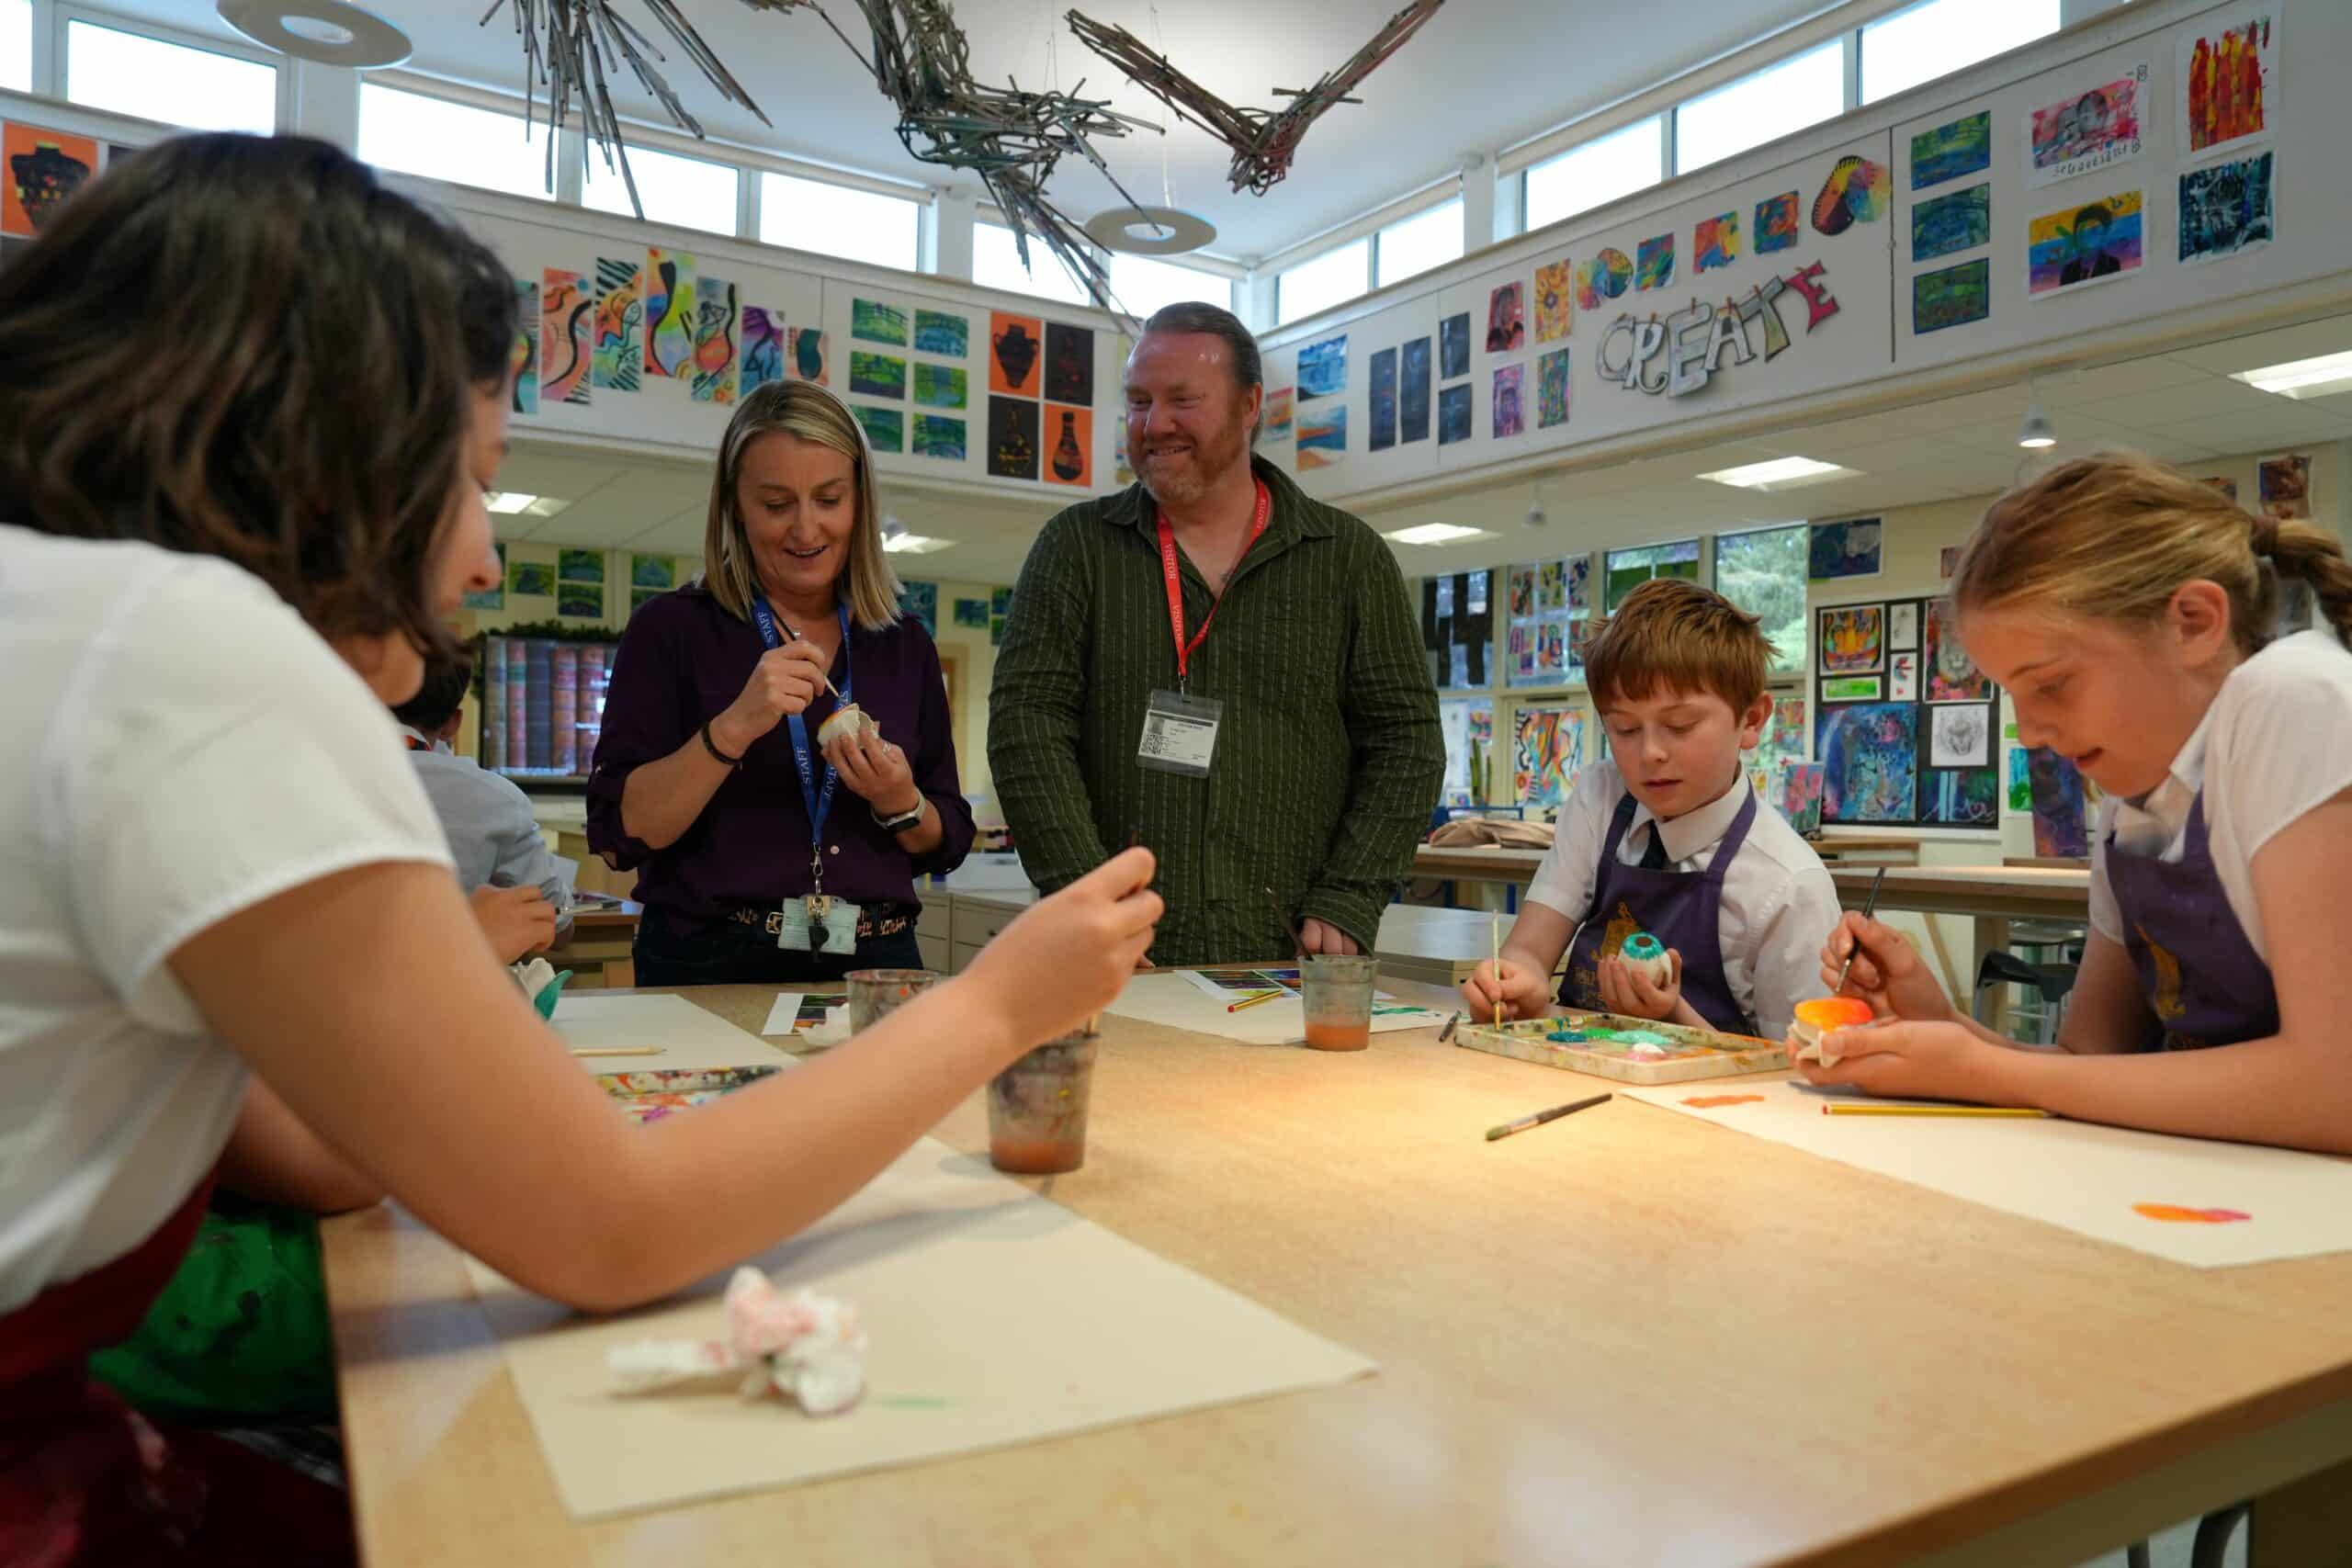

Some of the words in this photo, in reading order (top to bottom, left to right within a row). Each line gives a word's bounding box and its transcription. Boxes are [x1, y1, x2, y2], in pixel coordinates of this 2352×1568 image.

[1596, 261, 1840, 398] CREATE
[1165, 544, 1177, 581] VISITOR
[757, 611, 774, 643] STAFF
[796, 746, 810, 785] STAFF
